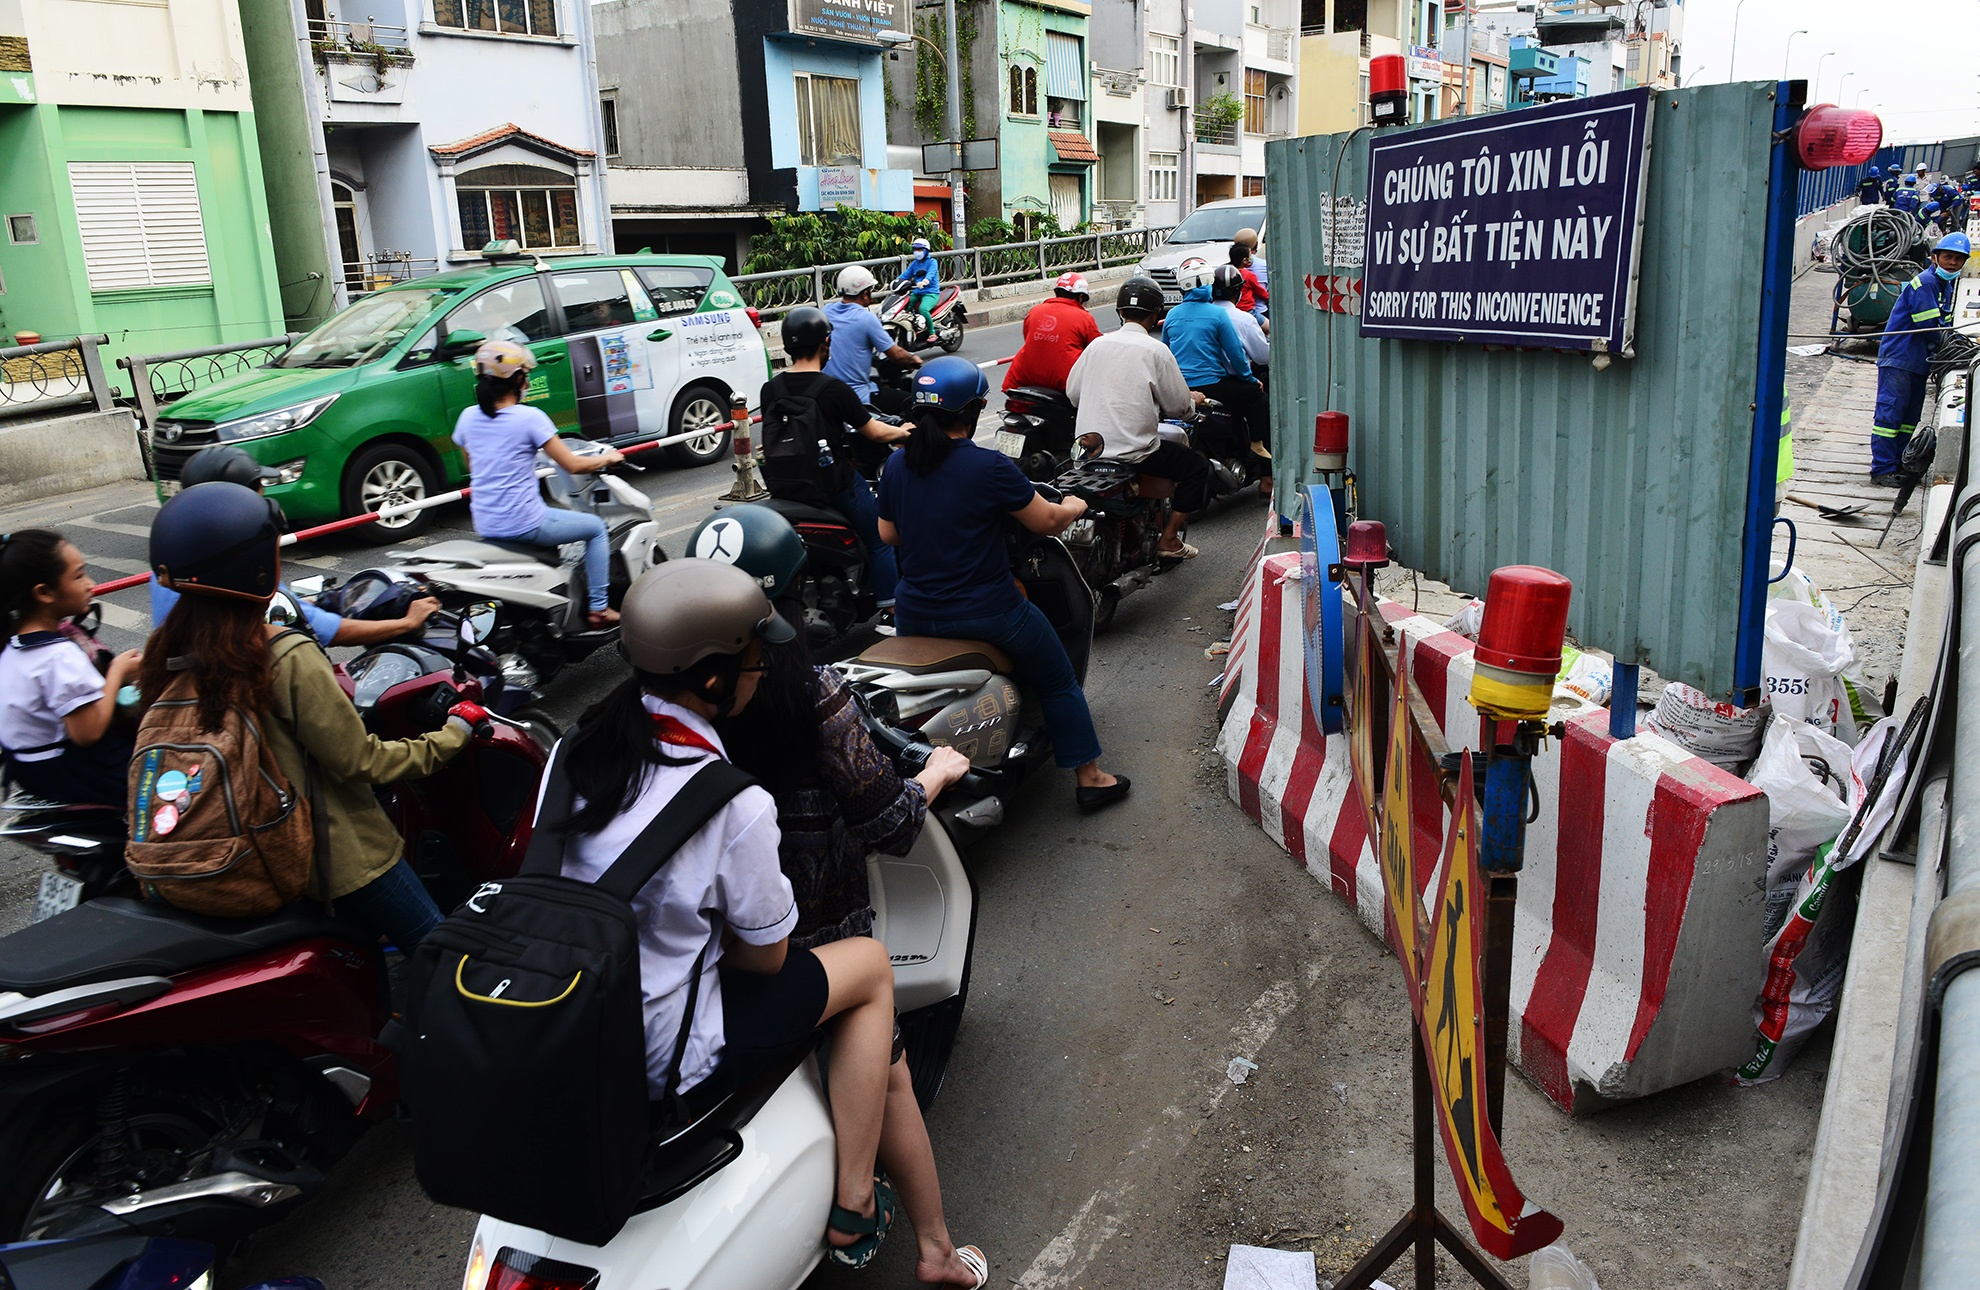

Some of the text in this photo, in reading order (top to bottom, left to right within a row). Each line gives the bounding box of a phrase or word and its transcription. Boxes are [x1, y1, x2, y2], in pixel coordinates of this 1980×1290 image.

[863, 0, 895, 16] VIỆT
[828, 19, 846, 30] NGHỆ
[847, 22, 866, 34] THUẬT
[871, 17, 892, 27] TRANH
[1383, 119, 1610, 206] CHÚNG TÔI XIN LỖI
[1374, 205, 1613, 271] VÌ SỰ BẤT TIỆN NÀY
[1369, 290, 1604, 326] SORRY FOR THIS INCONVENIENCE
[680, 312, 731, 327] SAMSUNG
[1033, 331, 1060, 343] goviet
